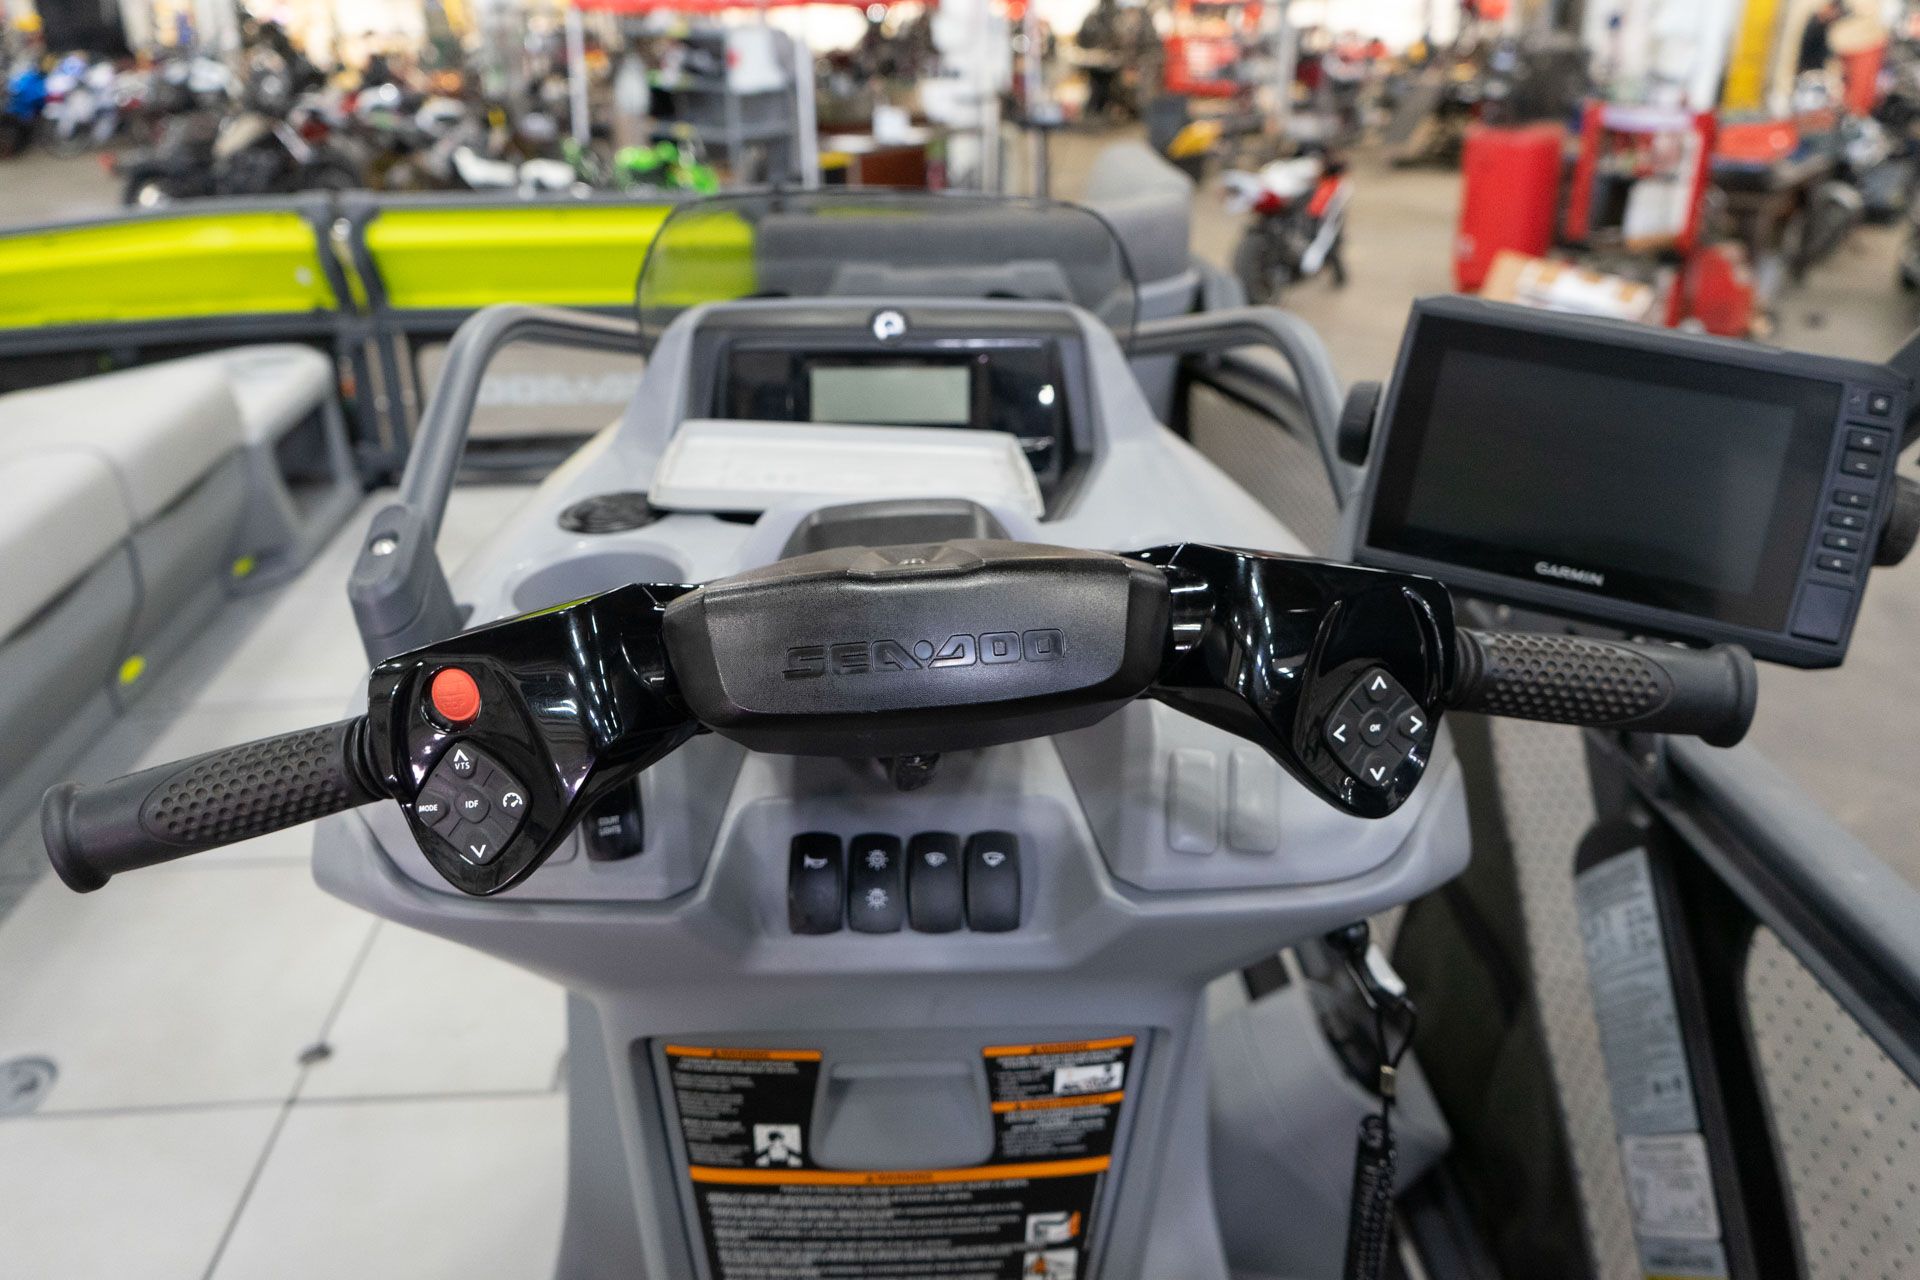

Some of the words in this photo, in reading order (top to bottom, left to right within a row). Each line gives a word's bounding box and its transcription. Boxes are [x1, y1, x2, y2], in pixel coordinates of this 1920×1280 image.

[1534, 561, 1605, 587] GARMIN
[1369, 724, 1382, 733] OK
[454, 762, 471, 770] VTS
[418, 804, 438, 812] MODE
[465, 800, 479, 808] IDF
